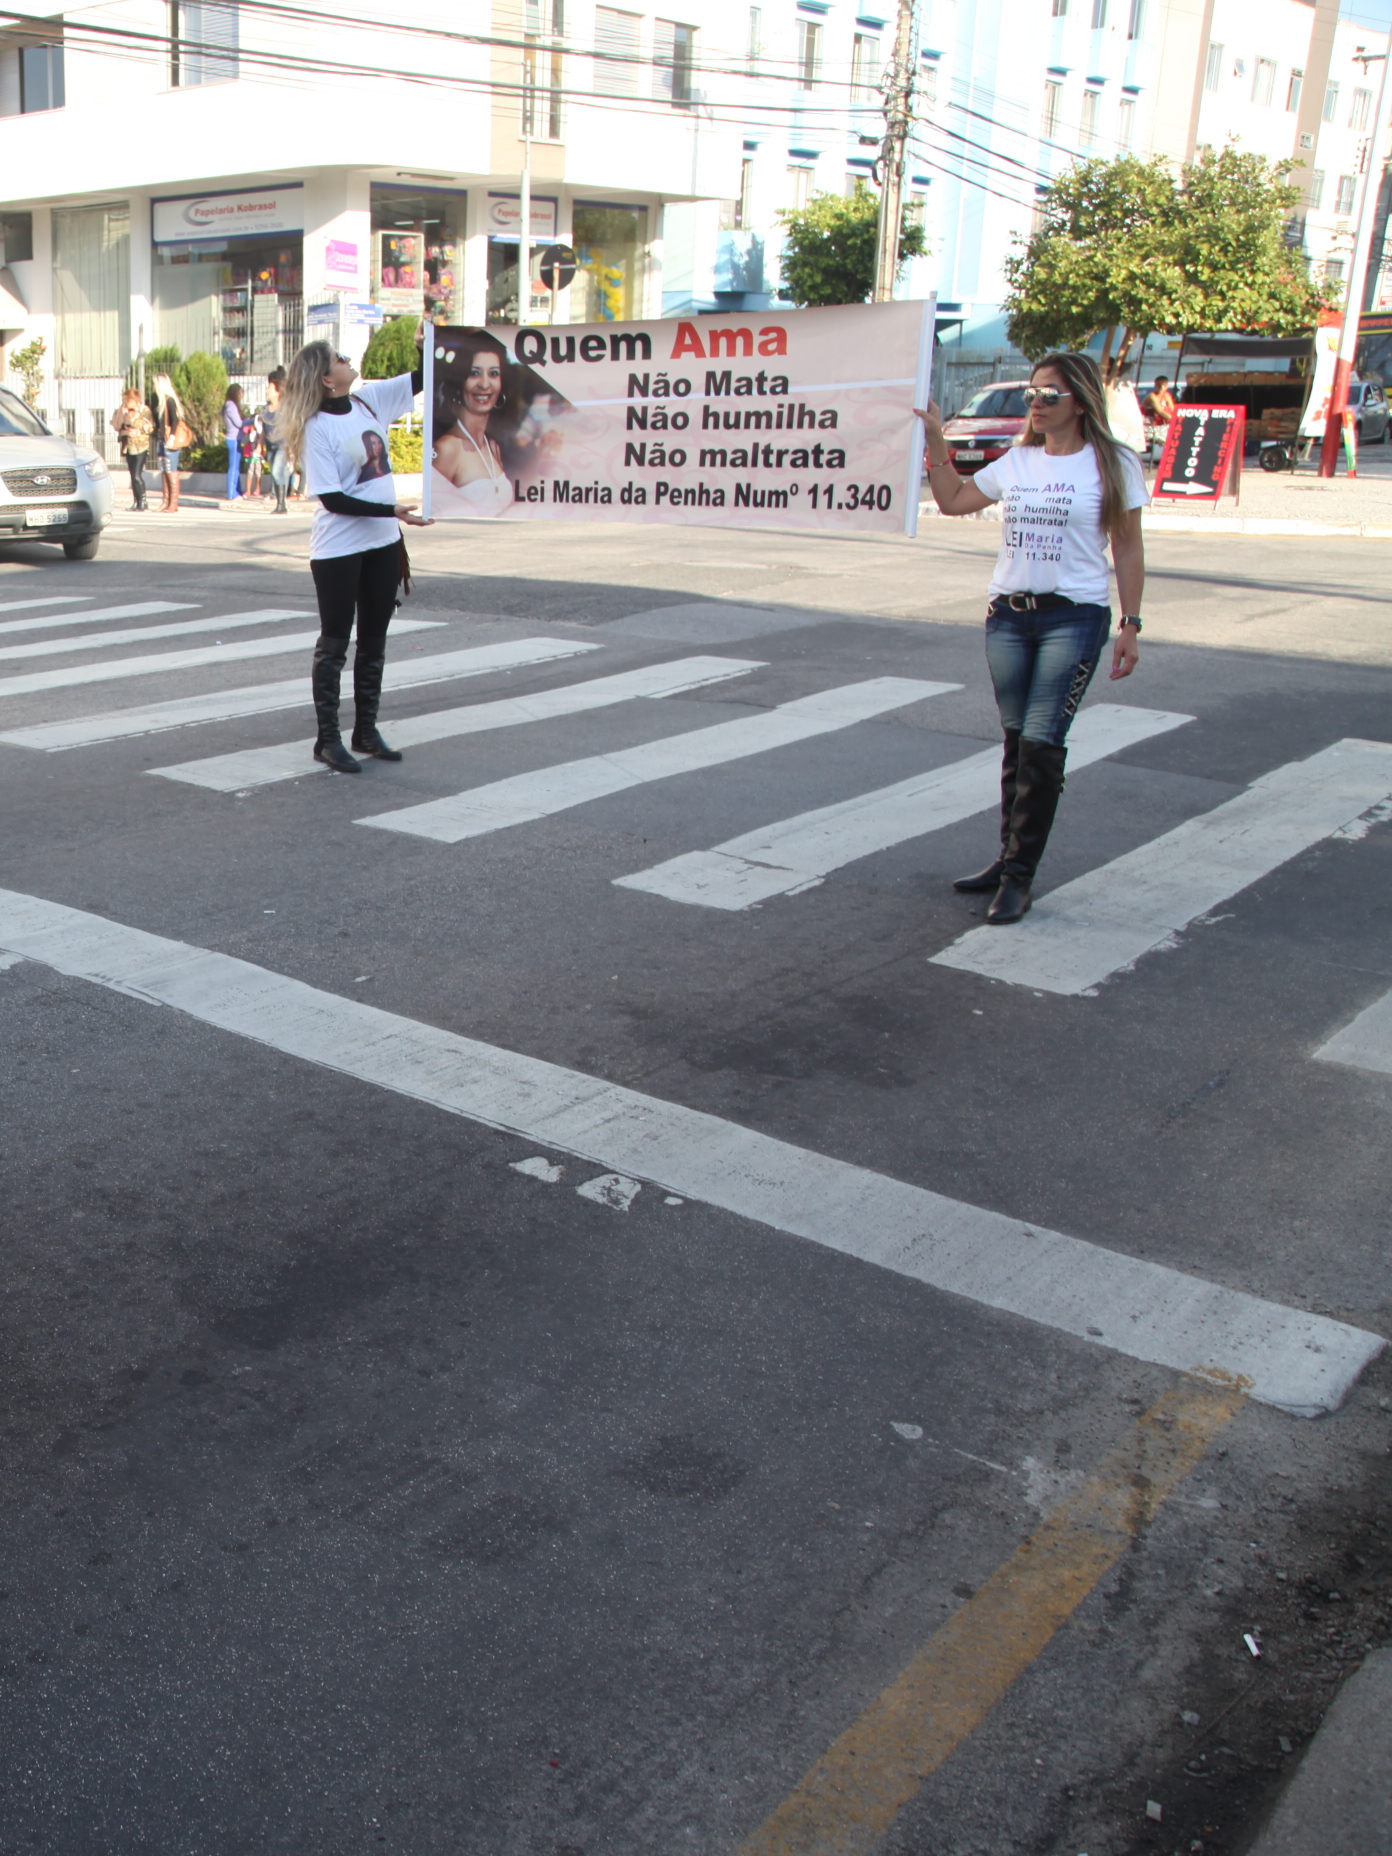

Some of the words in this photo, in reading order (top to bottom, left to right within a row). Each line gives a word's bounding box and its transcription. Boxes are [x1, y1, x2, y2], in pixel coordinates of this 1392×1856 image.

[194, 205, 235, 219] Papelaria
[237, 200, 277, 213] Kobrasol
[514, 328, 652, 368] Quem
[669, 321, 788, 360] Ama
[626, 371, 692, 399] Não
[704, 369, 790, 397] Mata
[625, 404, 690, 431] Não
[701, 402, 839, 431] humilha
[1176, 408, 1209, 418] NOVA
[1211, 409, 1236, 419] ERA
[623, 441, 688, 468] Não
[698, 441, 847, 469] maltrata
[1184, 416, 1209, 478] TATTOO
[514, 479, 545, 503] Lei
[552, 479, 613, 505] Maria
[620, 480, 647, 505] da
[654, 480, 726, 507] Penha
[807, 483, 893, 512] 11.340
[1010, 485, 1039, 493] Quem
[1041, 482, 1076, 494] AMA
[1044, 495, 1073, 505] mata
[1023, 504, 1070, 517] humilha
[1020, 516, 1068, 528] maltrata!
[1005, 530, 1023, 548] LEI
[1024, 532, 1064, 545] Maria
[1036, 543, 1062, 551] Penha
[1025, 551, 1062, 562] 11.340
